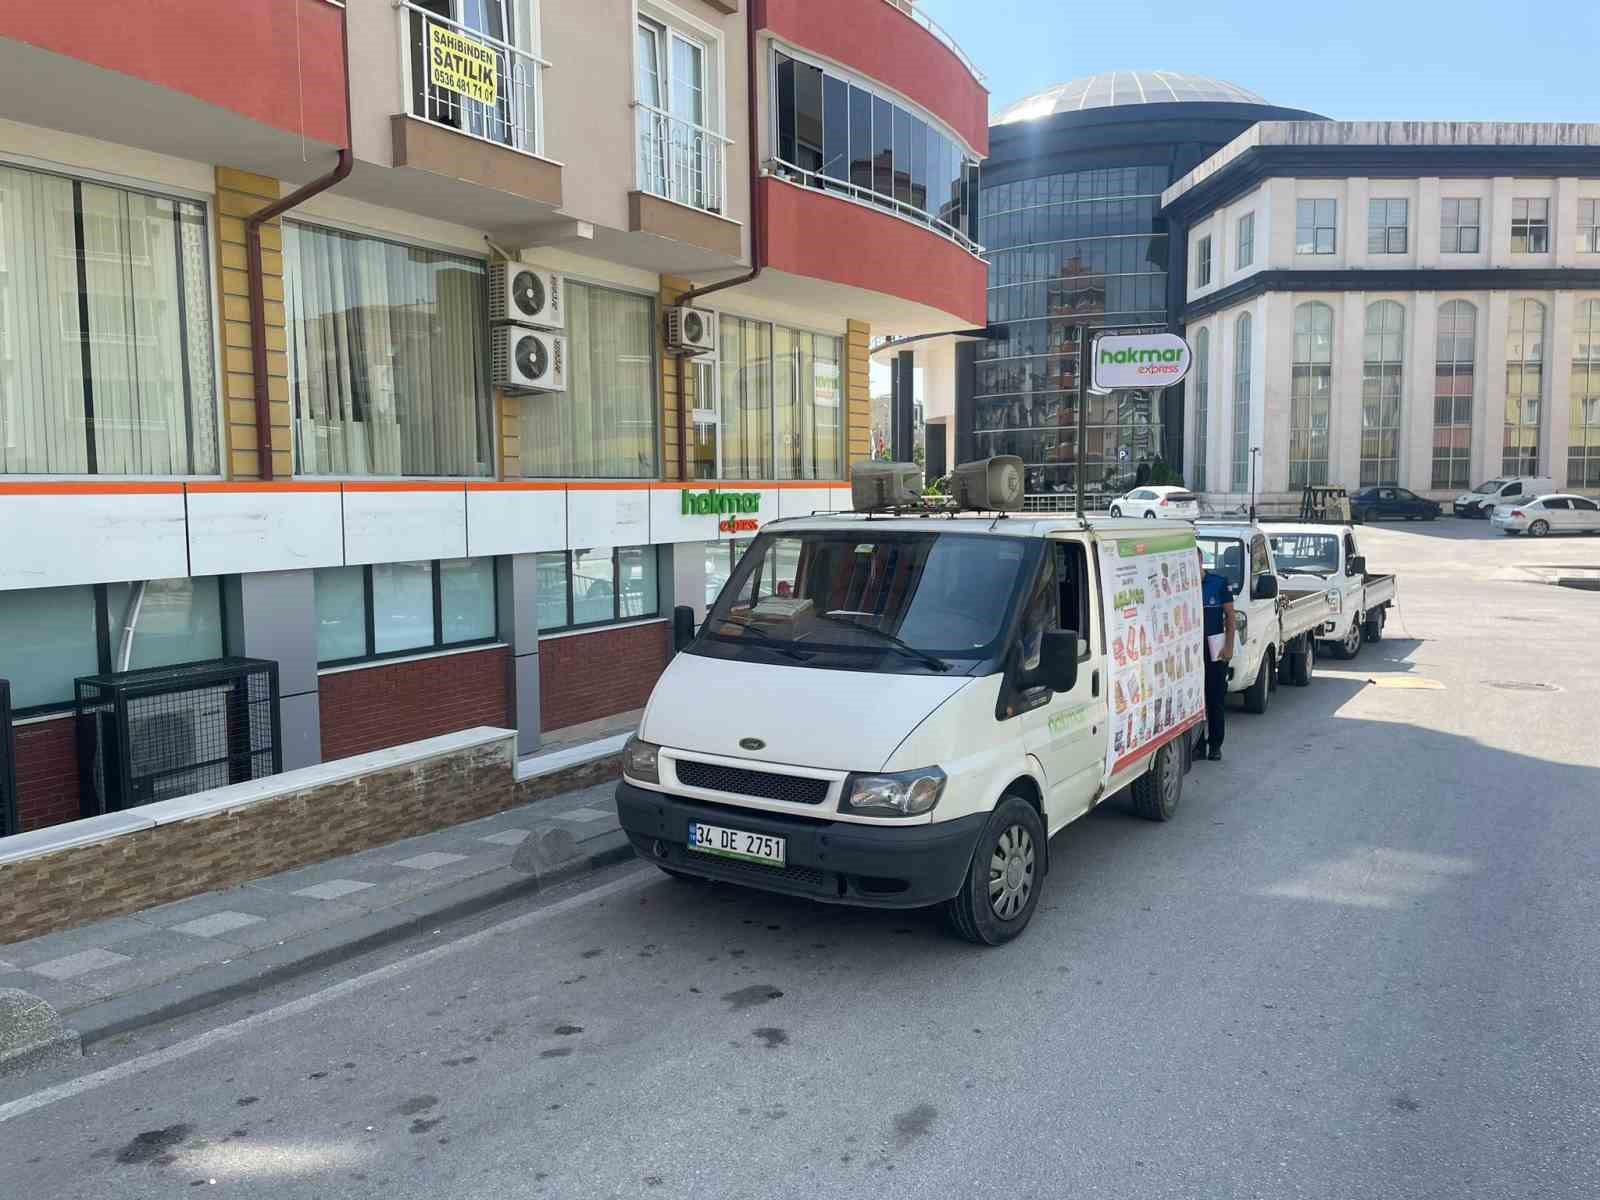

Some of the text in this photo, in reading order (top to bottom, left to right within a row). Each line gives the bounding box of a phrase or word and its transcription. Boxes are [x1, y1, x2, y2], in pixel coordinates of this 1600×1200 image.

[433, 47, 494, 87] SATILIK
[434, 68, 494, 102] 0536 481 71 01
[1101, 347, 1184, 364] hakmar
[1137, 364, 1179, 374] express
[681, 488, 761, 515] hakmar
[720, 516, 759, 533] express
[696, 826, 780, 859] 34 DE 2751
